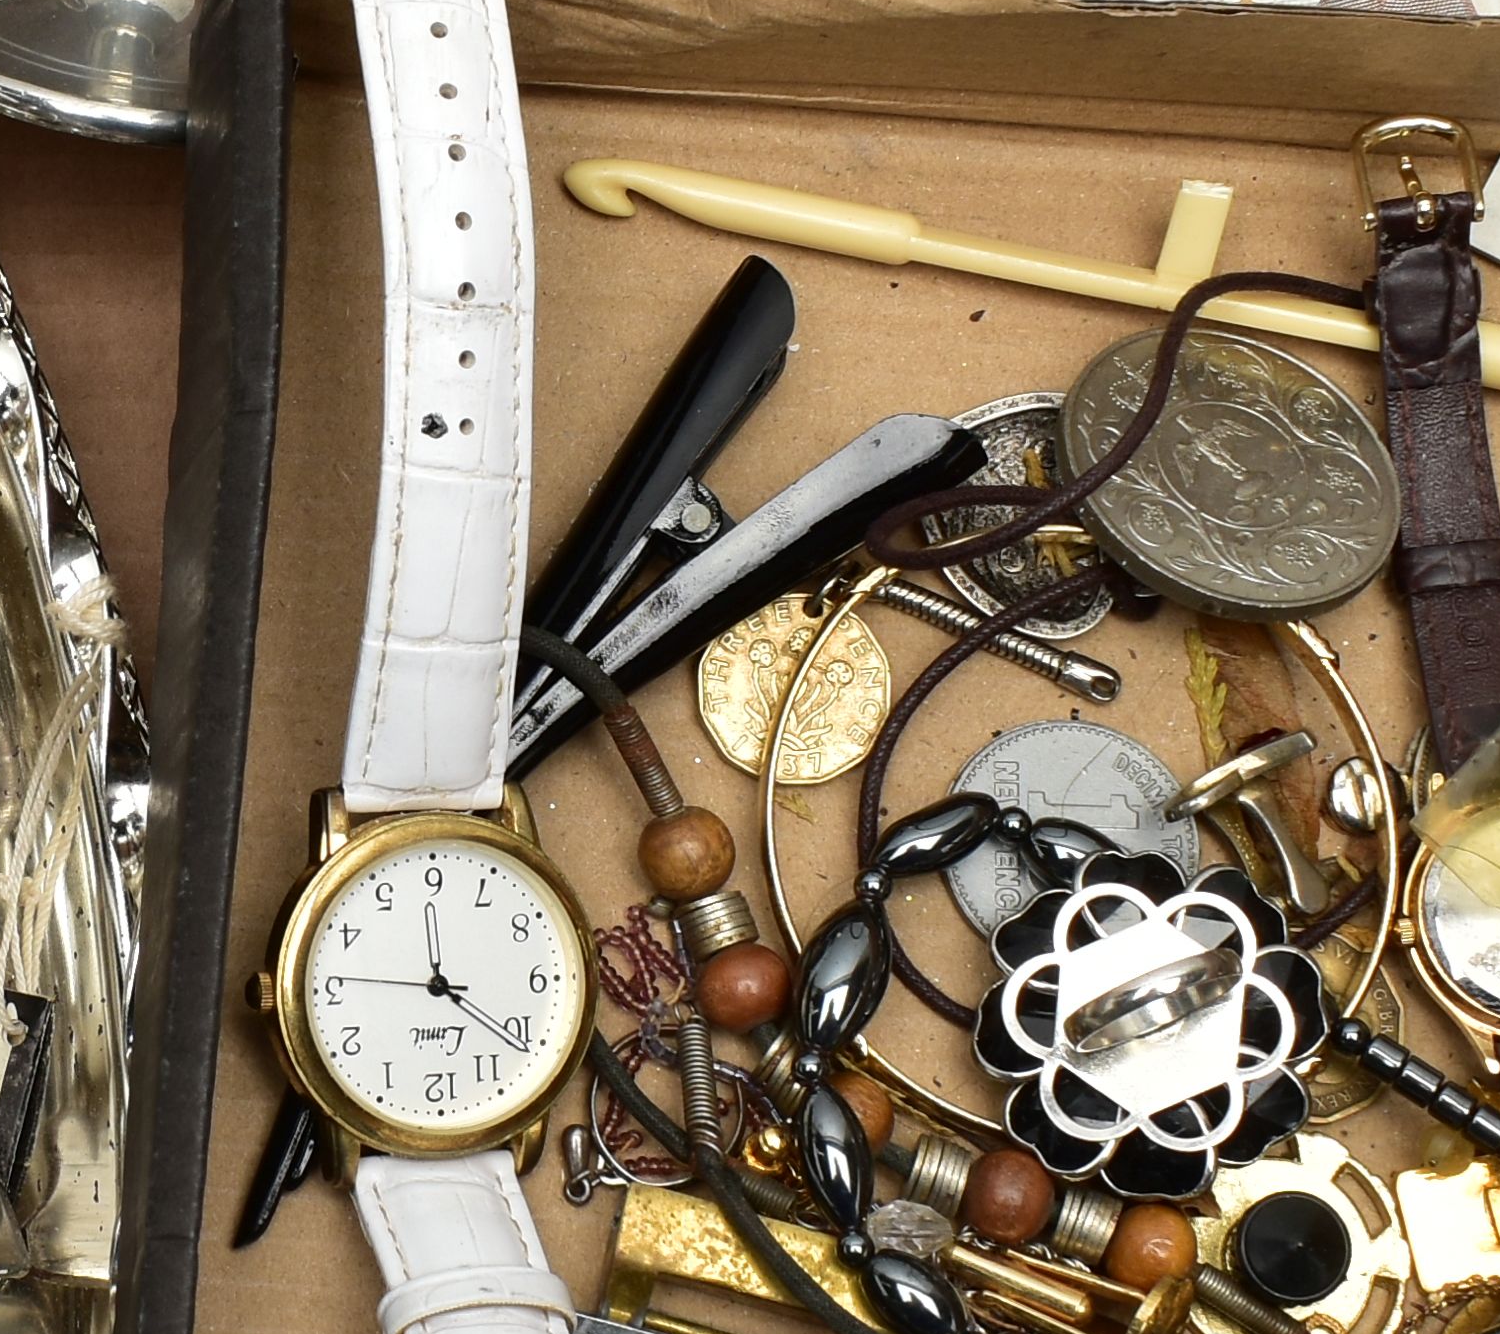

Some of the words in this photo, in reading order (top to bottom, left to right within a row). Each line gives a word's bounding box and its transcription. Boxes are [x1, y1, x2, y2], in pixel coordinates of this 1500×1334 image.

[705, 601, 790, 713] THREE
[424, 867, 443, 896] 6
[474, 878, 493, 907] 7
[375, 882, 394, 912] 5
[338, 922, 362, 951] 4
[511, 913, 530, 942] 8
[325, 975, 344, 1005] 3
[529, 964, 547, 993] 9
[340, 1026, 362, 1055] 2
[410, 1025, 468, 1056] Limit
[504, 1016, 532, 1044] 10
[382, 1062, 395, 1089] 1
[473, 1054, 501, 1083] 11
[423, 1072, 457, 1102] 12
